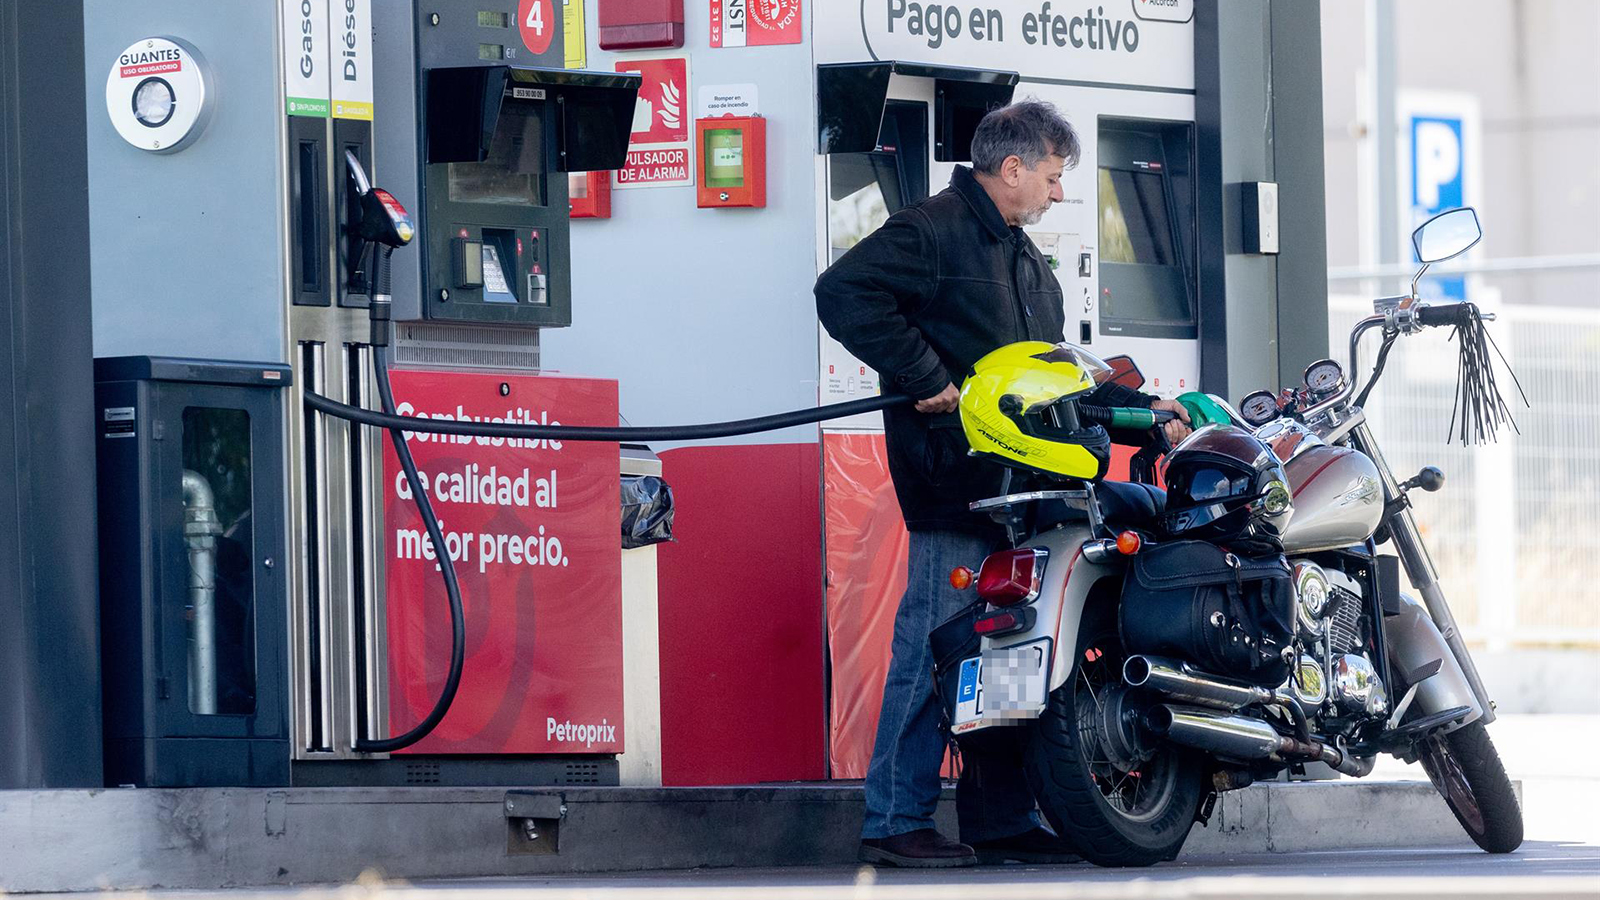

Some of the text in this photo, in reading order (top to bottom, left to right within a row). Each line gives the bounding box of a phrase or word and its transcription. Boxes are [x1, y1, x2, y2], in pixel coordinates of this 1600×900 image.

[526, 0, 543, 36] 4
[887, 0, 1140, 53] Pago en efectivo
[712, 26, 719, 42] 32
[120, 49, 181, 66] GUANTES
[137, 63, 178, 74] OBLIGATORIO
[620, 166, 687, 181] DE ALARMA
[1416, 121, 1460, 209] P
[396, 402, 563, 451] Combustible
[976, 428, 1028, 457] ASTONE
[434, 463, 529, 506] calidad
[535, 469, 557, 508] al
[480, 525, 569, 573] precio.
[964, 685, 972, 695] E
[546, 717, 616, 748] Petroprix
